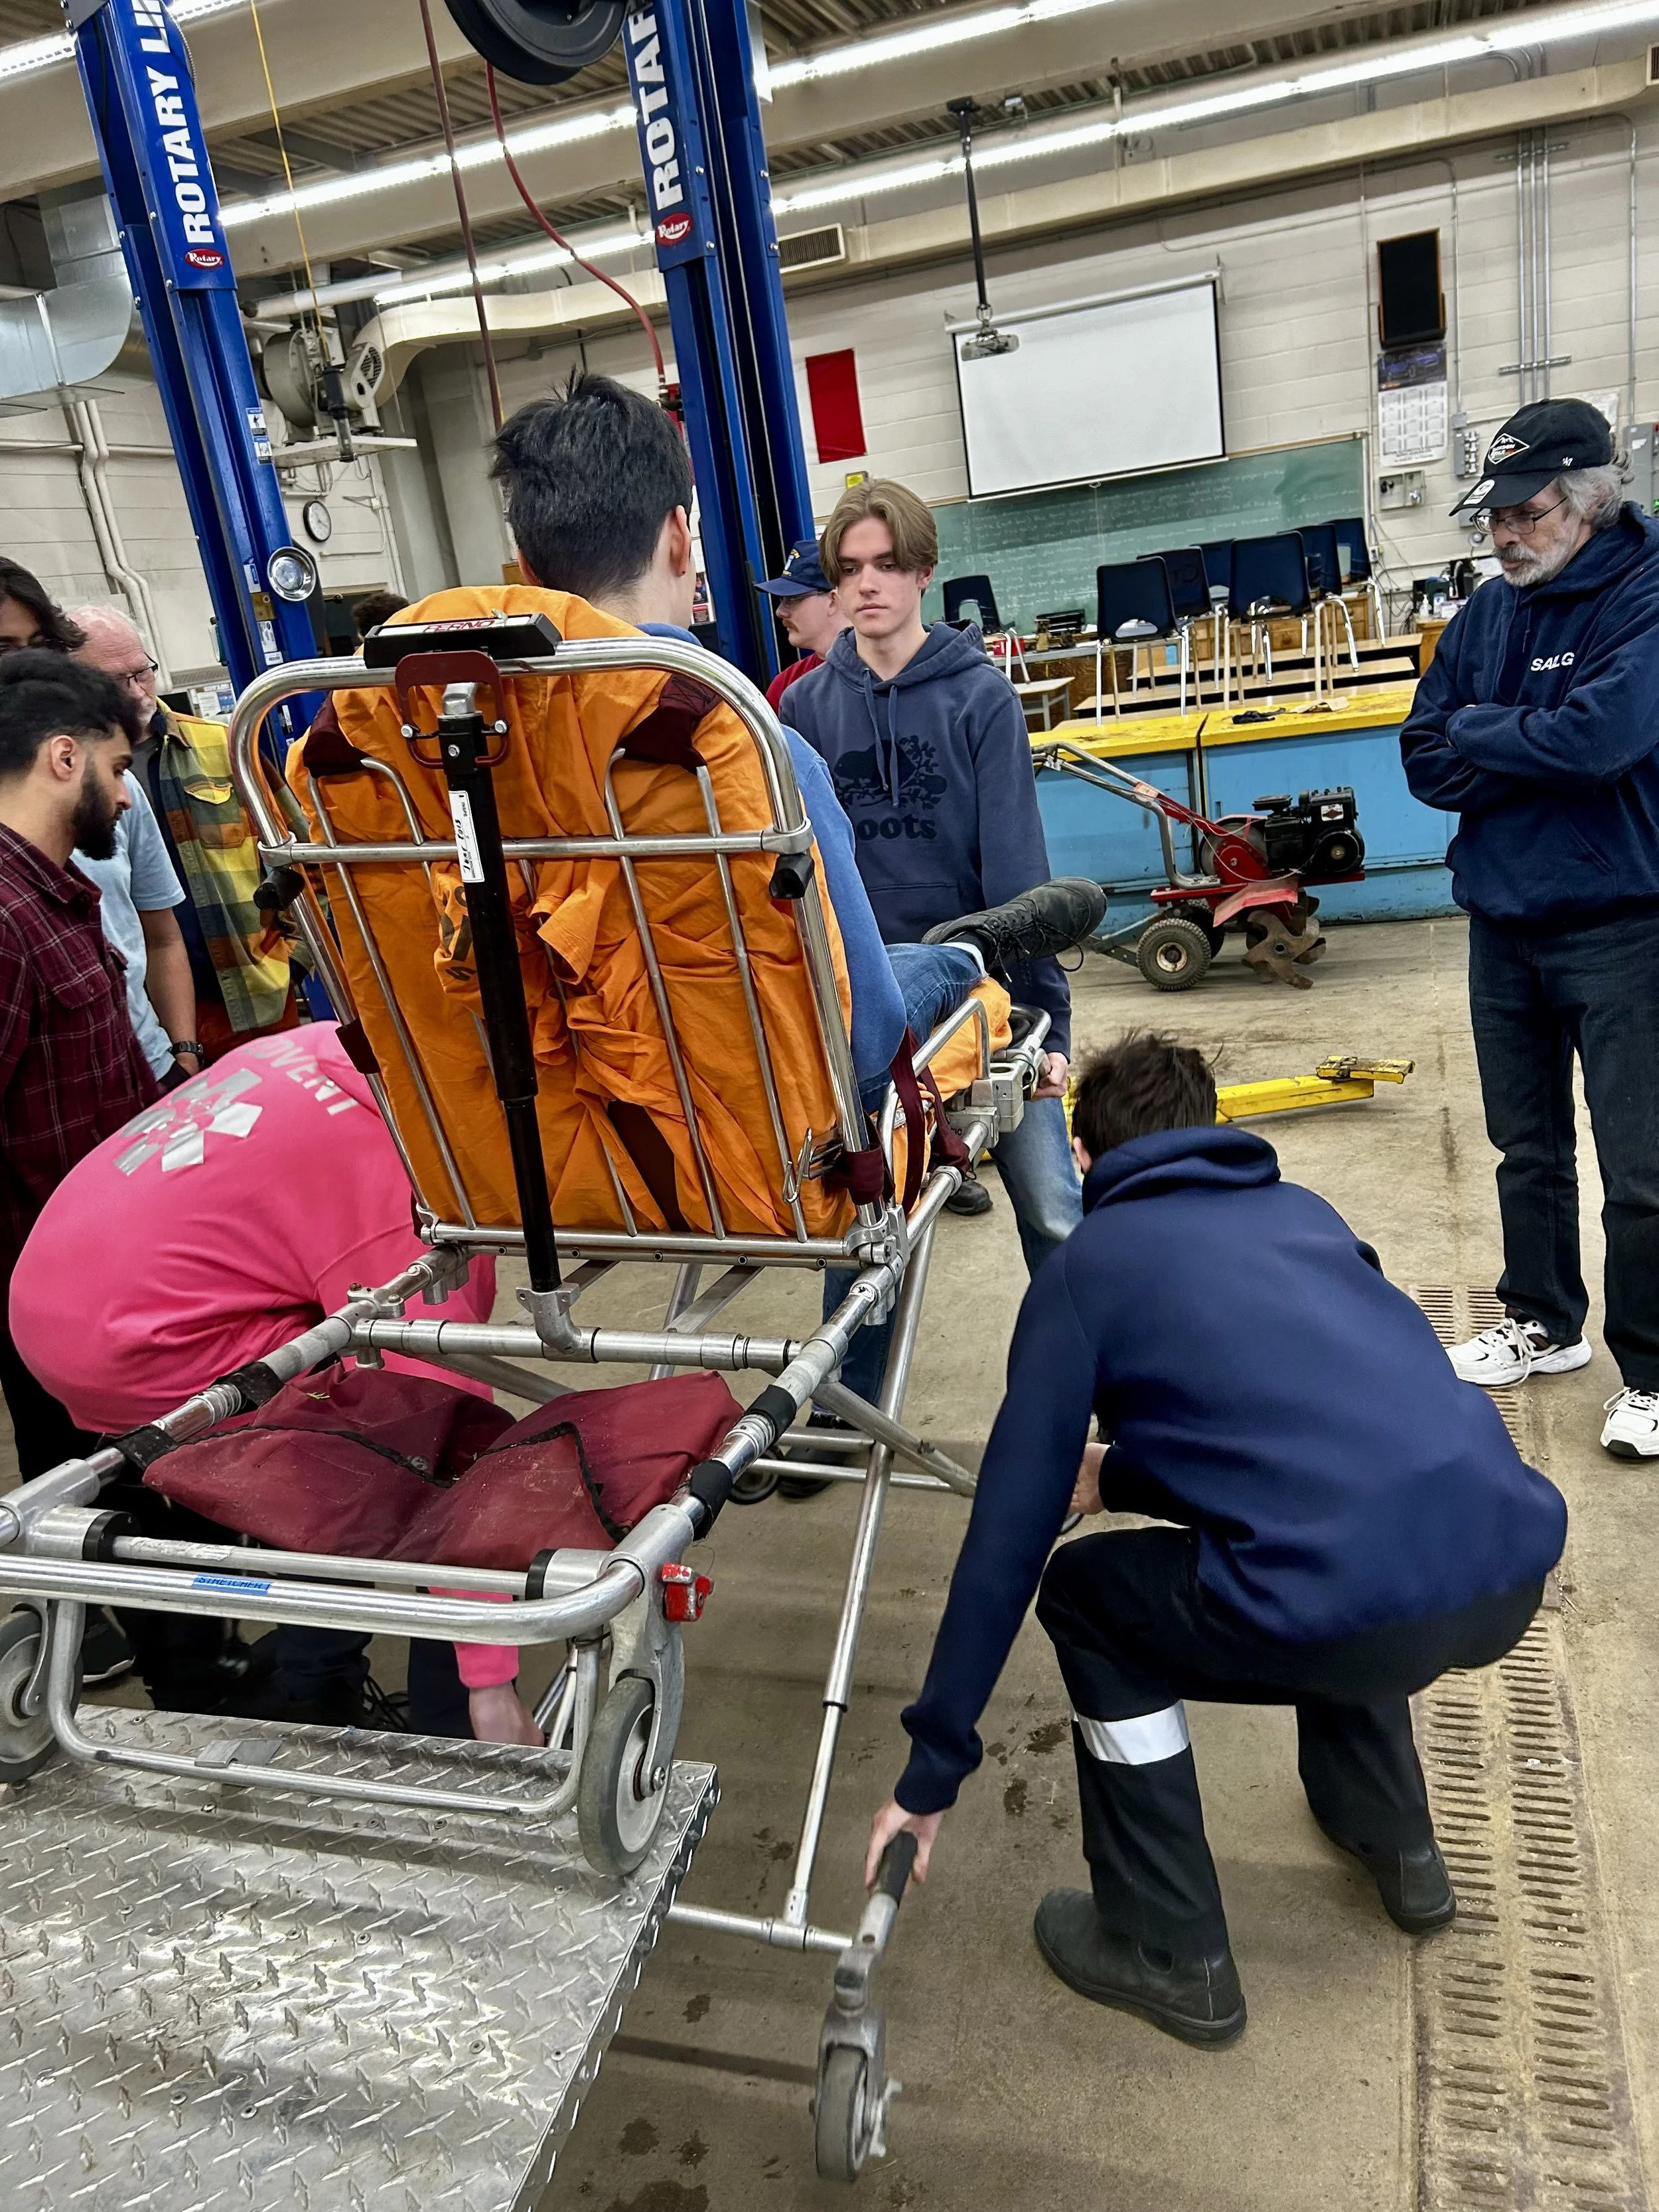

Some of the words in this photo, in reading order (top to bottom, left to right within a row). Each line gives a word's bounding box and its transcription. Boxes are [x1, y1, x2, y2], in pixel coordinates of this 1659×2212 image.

[628, 11, 684, 211] ROTAR
[145, 65, 215, 243] ROTARY
[658, 220, 689, 240] Rotary
[187, 252, 222, 267] Rotary
[855, 814, 938, 841] oots
